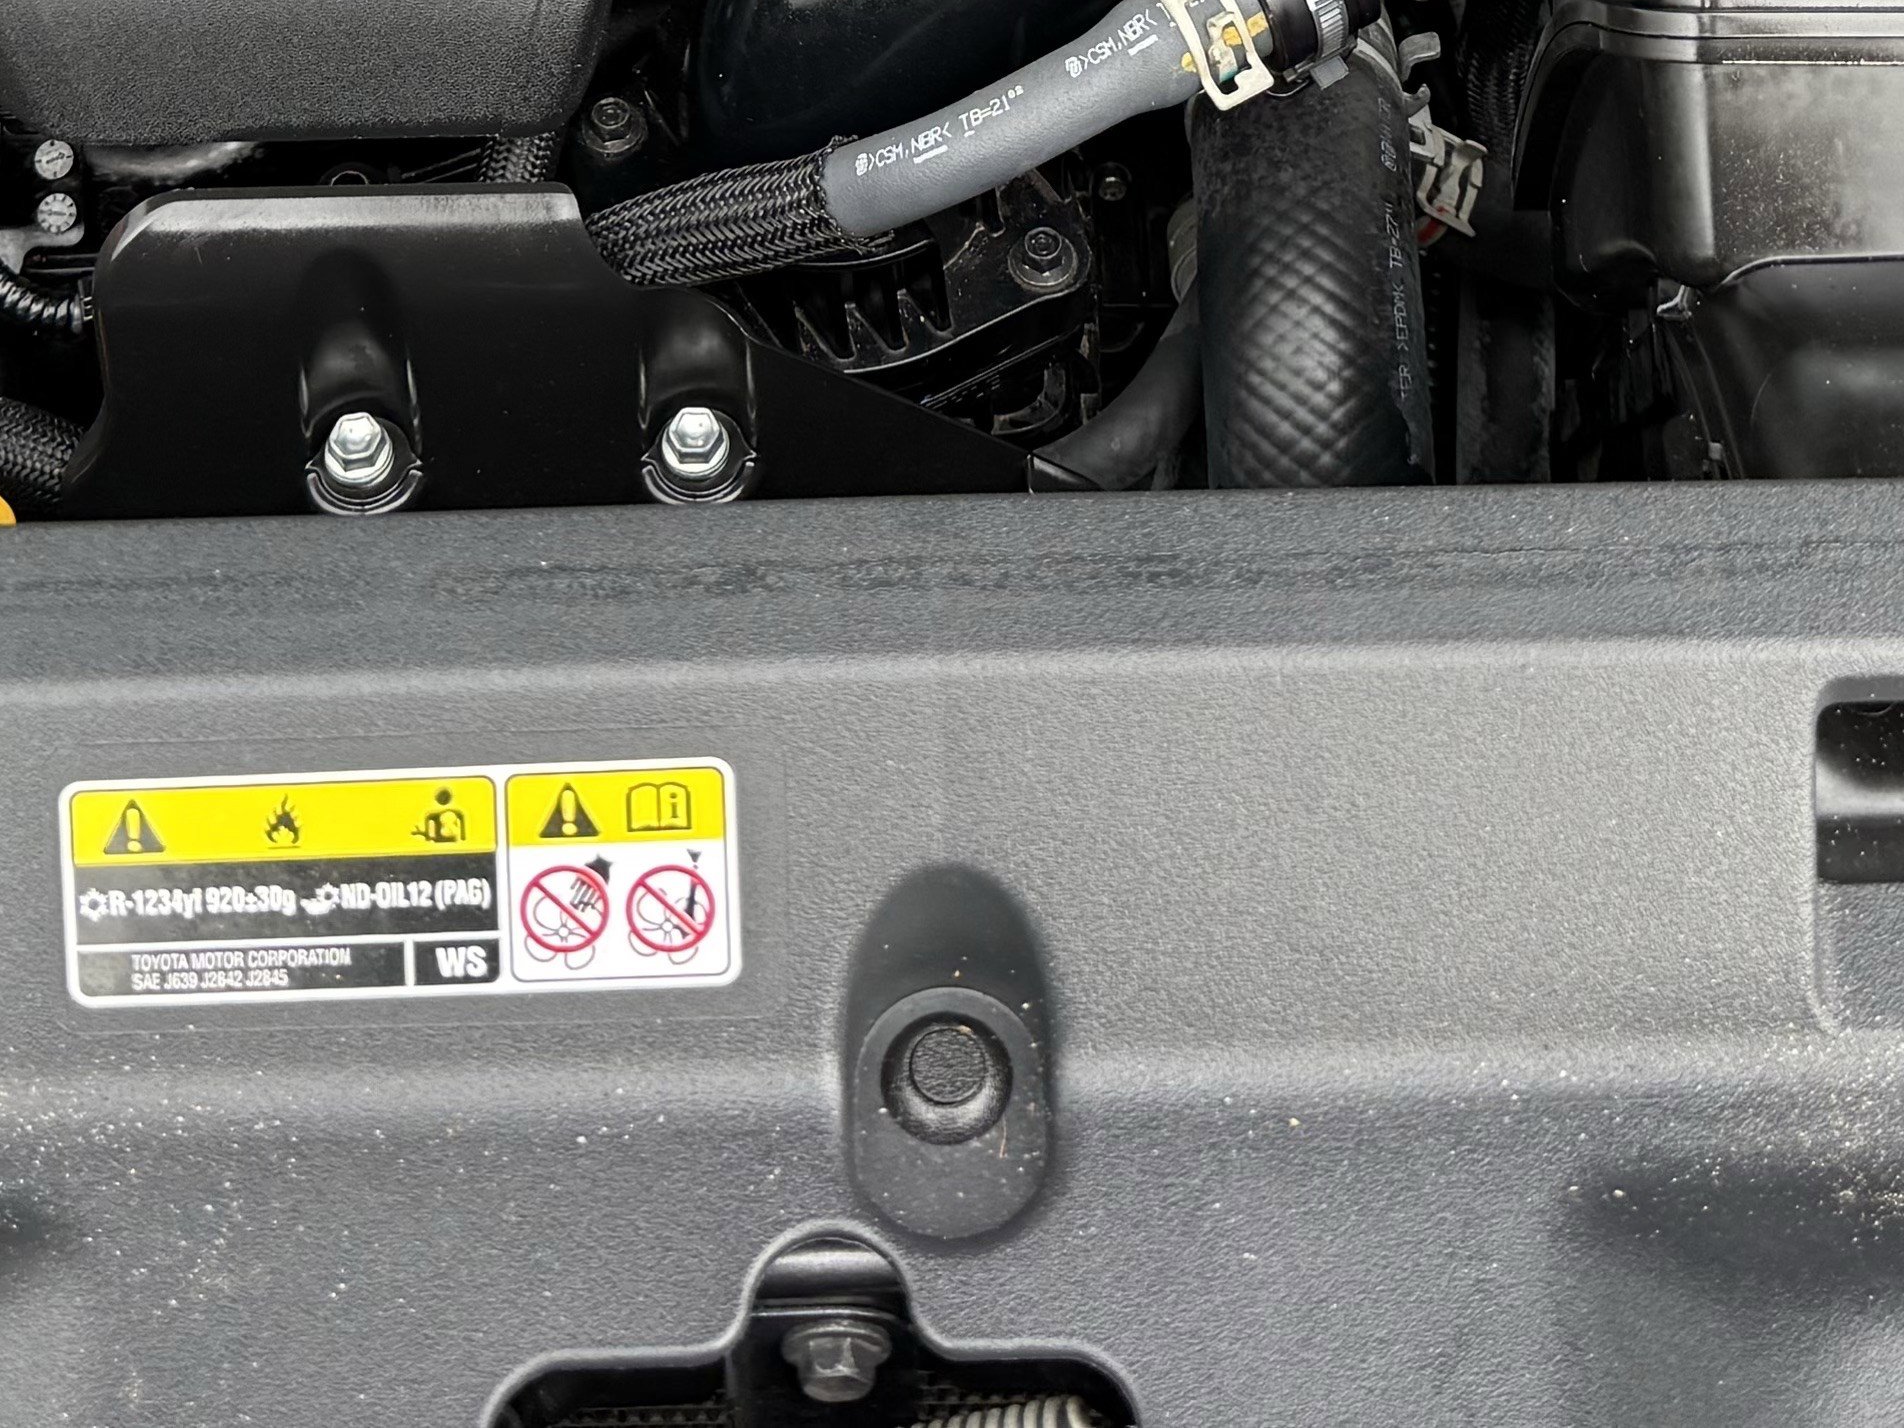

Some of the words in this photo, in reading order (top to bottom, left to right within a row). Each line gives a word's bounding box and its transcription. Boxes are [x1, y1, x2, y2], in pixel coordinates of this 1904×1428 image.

[108, 888, 202, 919] R-1234yf
[206, 887, 296, 917] 920±30g
[340, 881, 433, 910] ND-OIL12
[435, 879, 492, 911] (PAG)
[131, 952, 188, 972] TOYOTA
[192, 950, 245, 970] MOTOR
[247, 947, 351, 968] CORPORATION
[435, 947, 488, 978] WS
[131, 973, 161, 991] SAE
[163, 972, 199, 990] J639
[201, 971, 243, 989] J2842
[246, 970, 289, 987] J2845
